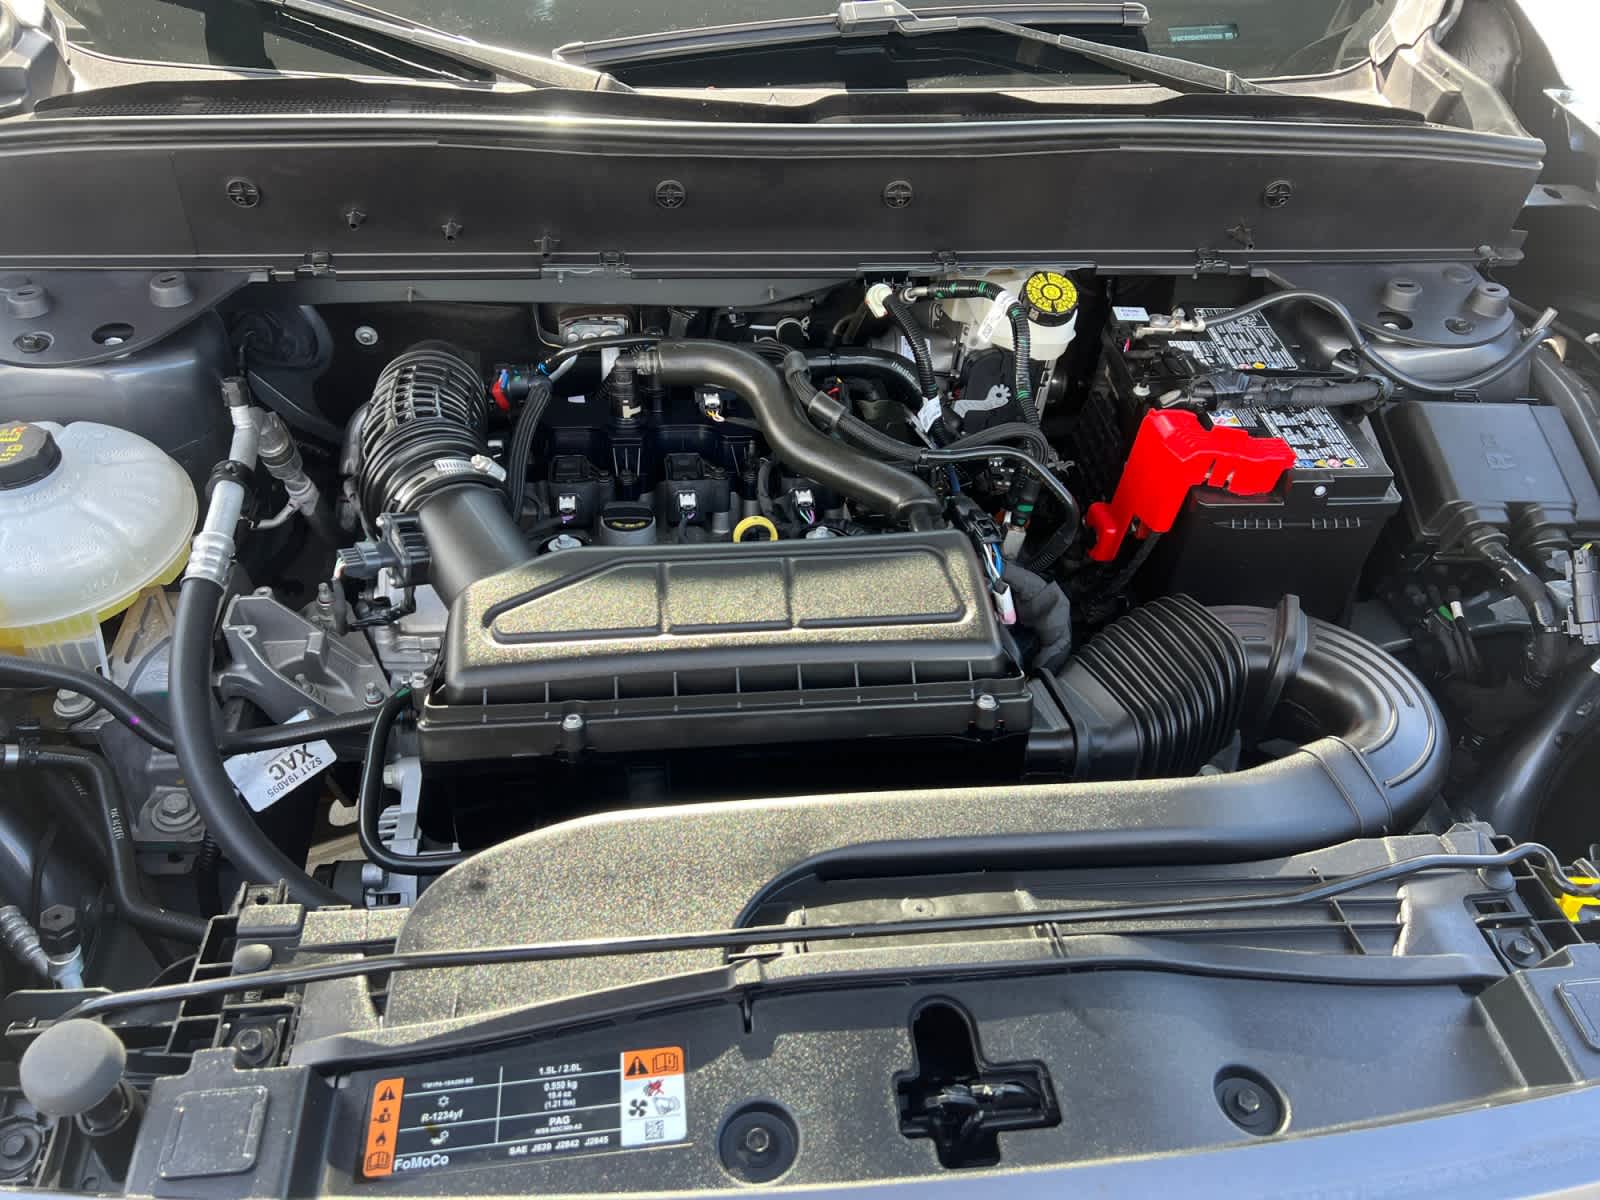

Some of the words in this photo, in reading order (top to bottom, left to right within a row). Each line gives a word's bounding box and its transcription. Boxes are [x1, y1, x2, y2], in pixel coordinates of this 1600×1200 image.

[268, 743, 315, 781] XAC
[266, 774, 300, 798] 19A095
[421, 1108, 464, 1123] R-1234yf
[548, 1115, 571, 1126] PAG
[508, 1145, 528, 1156] SAE
[393, 1153, 450, 1171] FoMoCo
